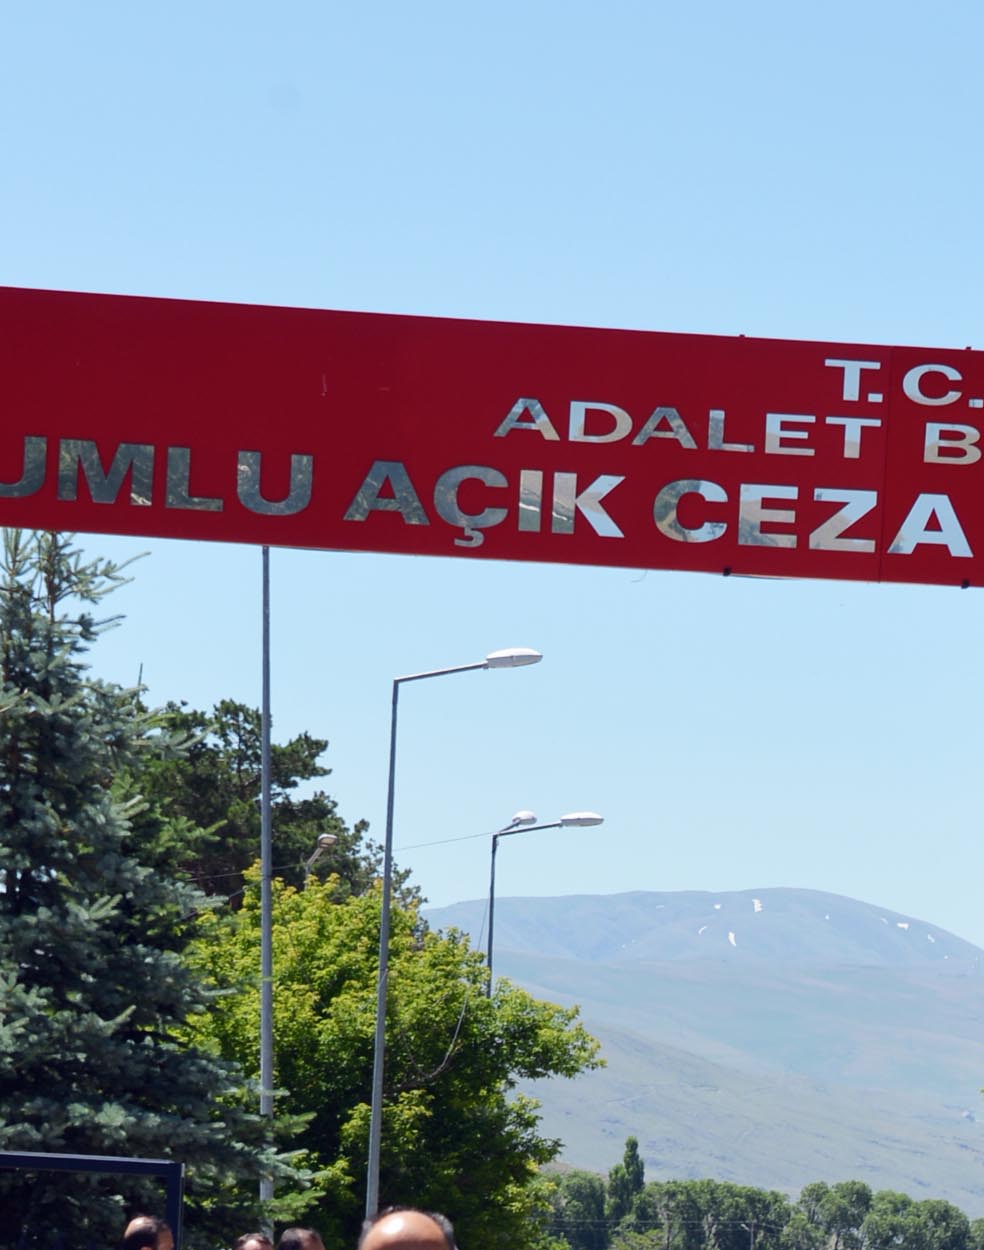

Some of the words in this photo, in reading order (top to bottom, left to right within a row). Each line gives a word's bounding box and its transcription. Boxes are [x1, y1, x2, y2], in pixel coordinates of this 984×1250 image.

[823, 357, 984, 409] T.C.
[494, 395, 883, 459] ADALET
[343, 458, 625, 548] AÇIK
[651, 477, 975, 562] CEZA
